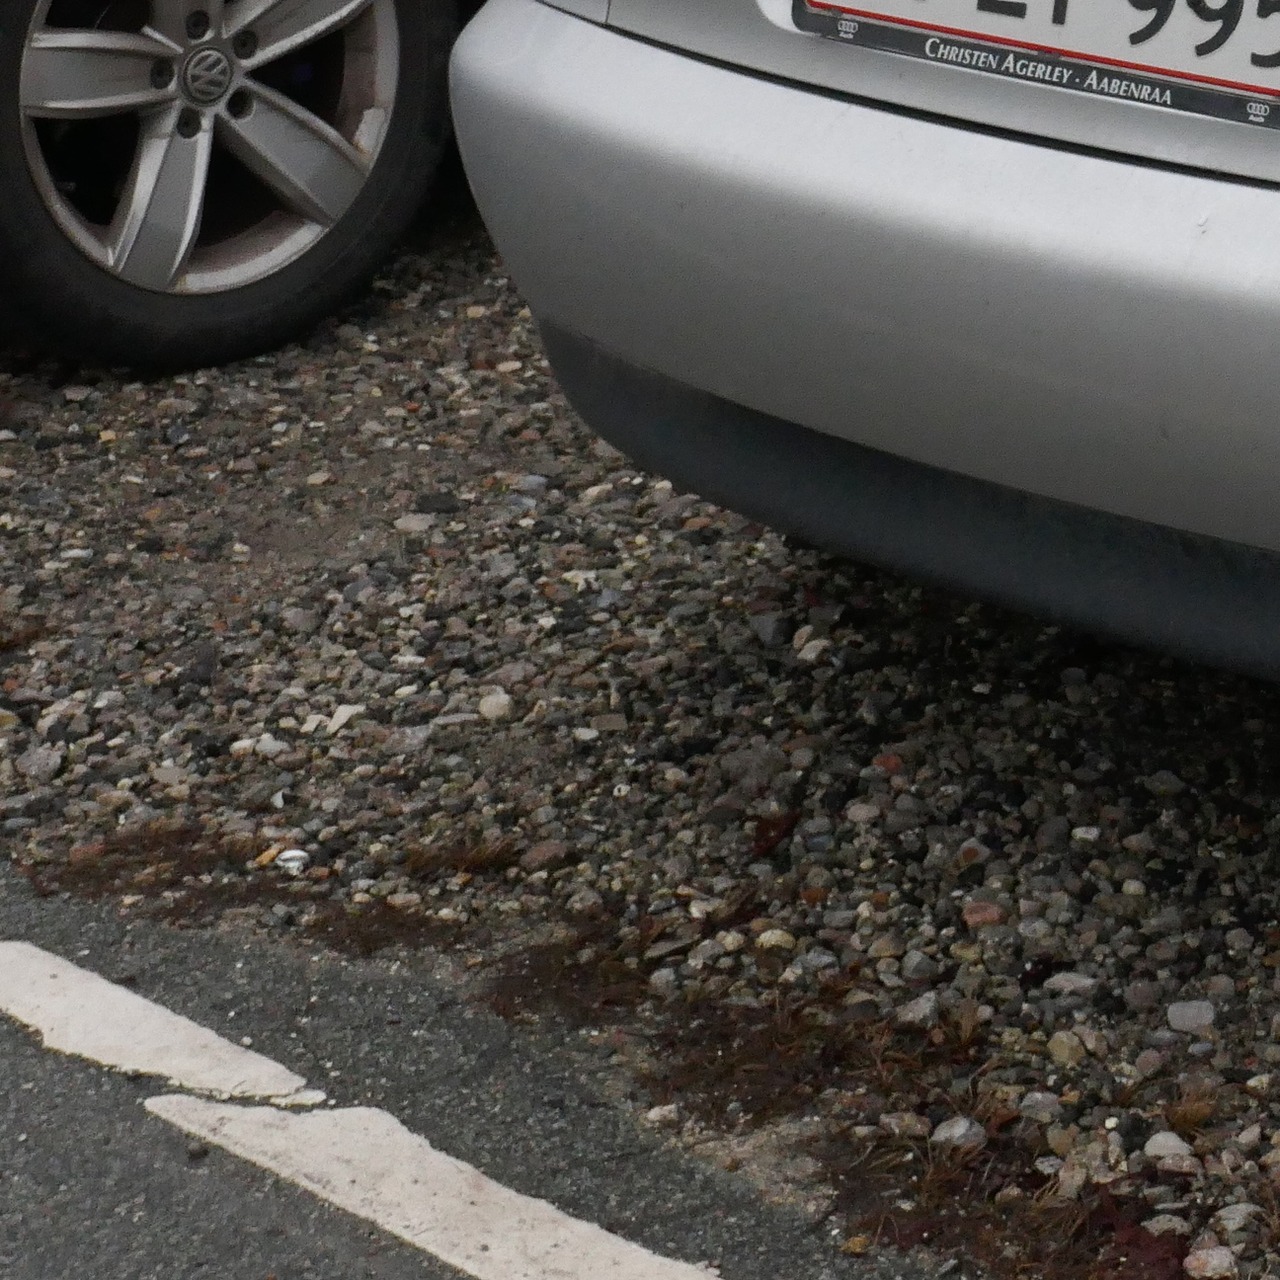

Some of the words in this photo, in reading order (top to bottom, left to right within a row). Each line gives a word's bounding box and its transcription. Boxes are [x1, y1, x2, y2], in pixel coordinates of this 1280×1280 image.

[925, 37, 999, 70] CHRISTEN
[1001, 53, 1073, 84] AGERLEY
[1083, 70, 1173, 106] AABENRAA
